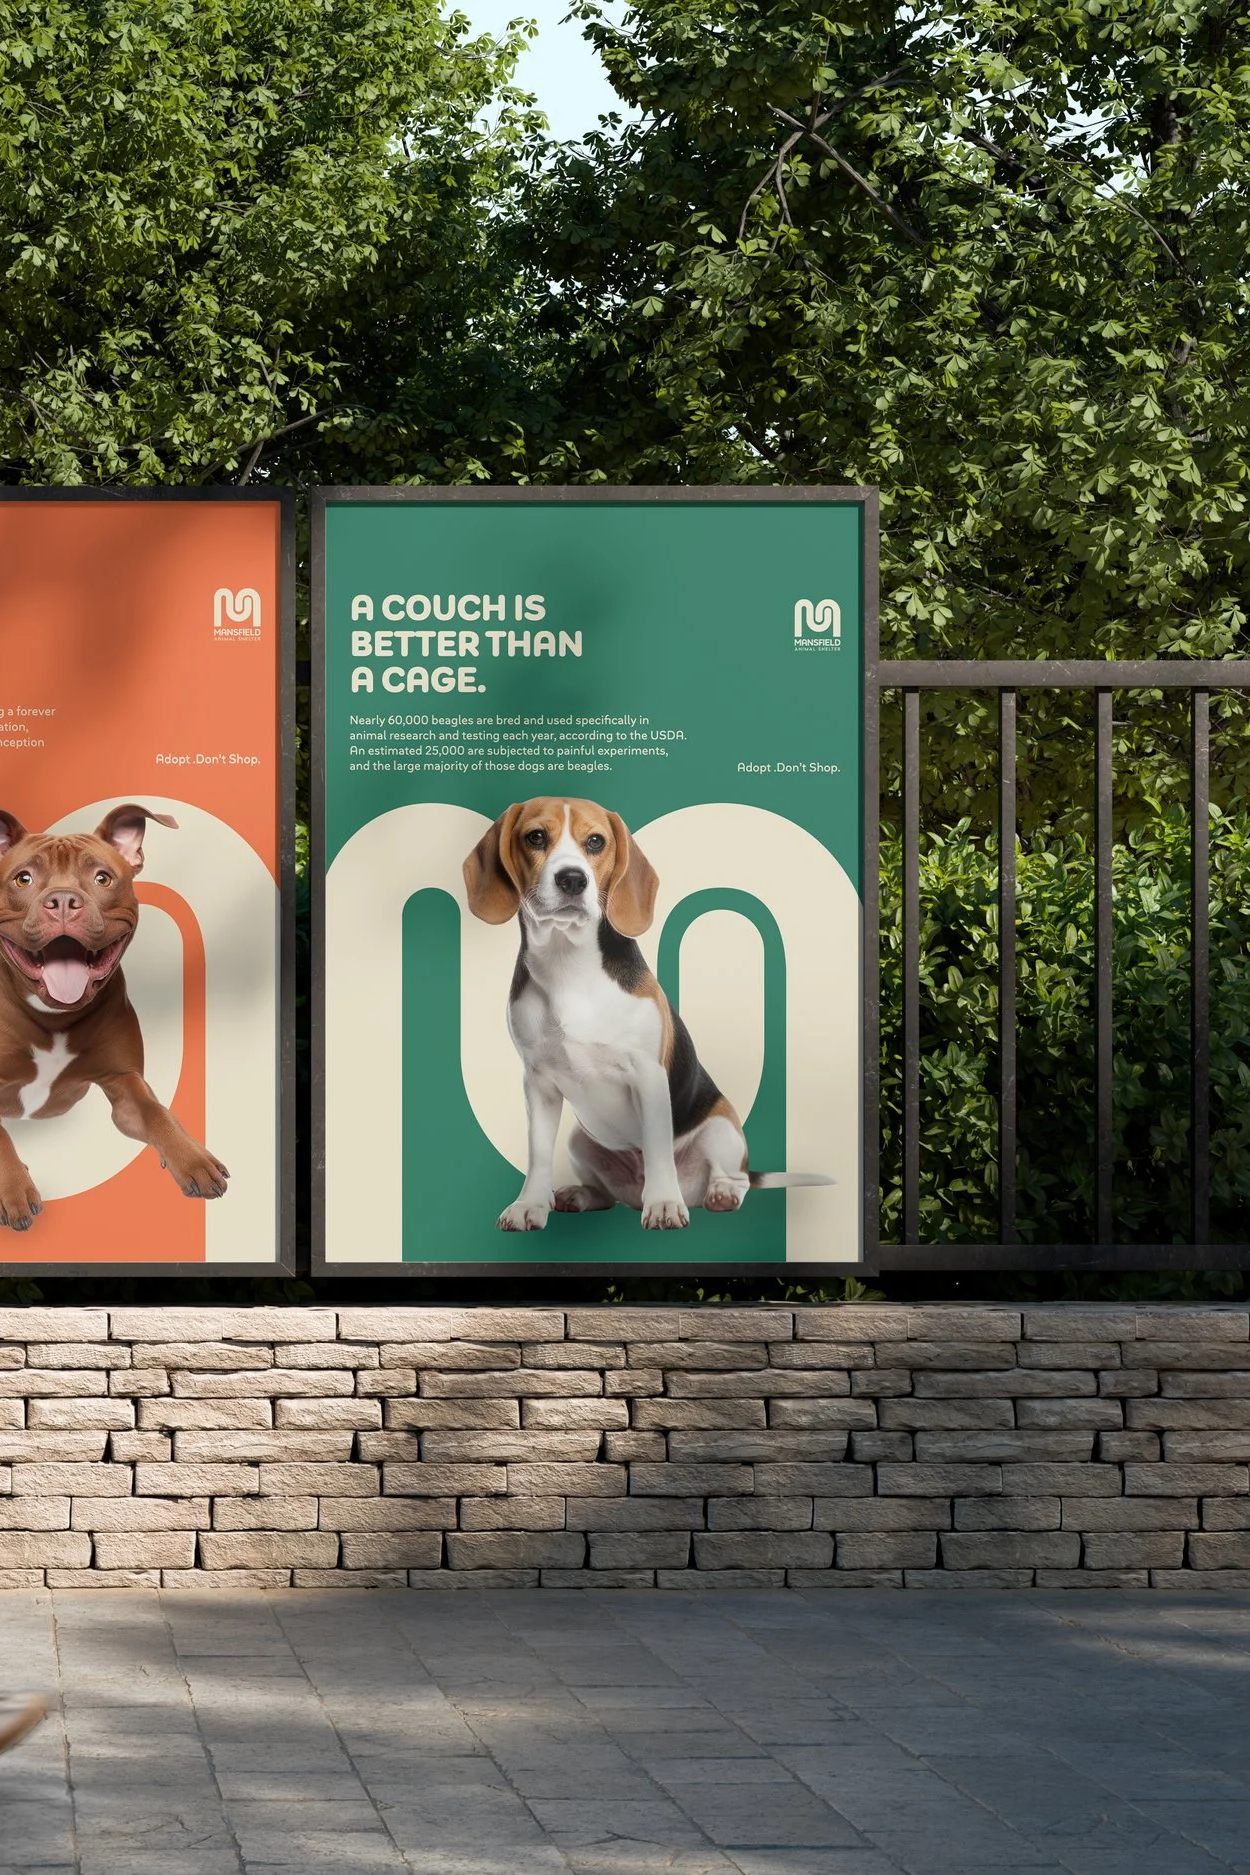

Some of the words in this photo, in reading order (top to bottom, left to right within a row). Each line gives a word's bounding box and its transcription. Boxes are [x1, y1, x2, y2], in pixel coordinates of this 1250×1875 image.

[352, 594, 373, 621] A
[382, 594, 505, 621] COUCH
[515, 595, 546, 621] IS
[213, 628, 261, 636] MANSFIELD
[352, 631, 479, 657] BETTER
[485, 631, 582, 657] THAN
[794, 638, 841, 647] MANSFIELD
[352, 667, 373, 693] A
[382, 667, 486, 693] CAGE.
[6, 708, 14, 717] a
[15, 705, 56, 717] forever
[349, 714, 386, 728] Nearly
[387, 714, 429, 727] 60,000
[431, 714, 475, 728] beagles
[476, 717, 494, 726] are
[495, 714, 521, 726] bred
[523, 714, 544, 726] and
[546, 714, 573, 726] used
[575, 714, 637, 728] specifically
[639, 714, 650, 725] in
[349, 729, 387, 741] animal
[389, 729, 437, 741] research
[438, 729, 460, 741] and
[461, 730, 500, 743] testing
[502, 729, 529, 741] each
[530, 732, 557, 743] year,
[558, 729, 614, 743] according
[615, 731, 628, 741] to
[629, 729, 648, 741] the
[650, 729, 687, 741] USDA.
[349, 745, 366, 756] An
[367, 744, 423, 756] estimated
[425, 745, 465, 758] 25,000
[467, 747, 485, 756] are
[486, 744, 541, 758] subjected
[542, 746, 555, 756] to
[556, 744, 595, 758] painful
[597, 745, 669, 758] experiments,
[229, 754, 261, 766] Shop.
[349, 759, 370, 771] and
[372, 760, 391, 771] the
[393, 760, 421, 774] large
[423, 760, 470, 774] majority
[470, 759, 483, 771] of
[484, 760, 516, 771] those
[517, 759, 545, 774] dogs
[547, 763, 565, 771] are
[567, 759, 613, 774] beagles.
[809, 762, 841, 774] Shop.
